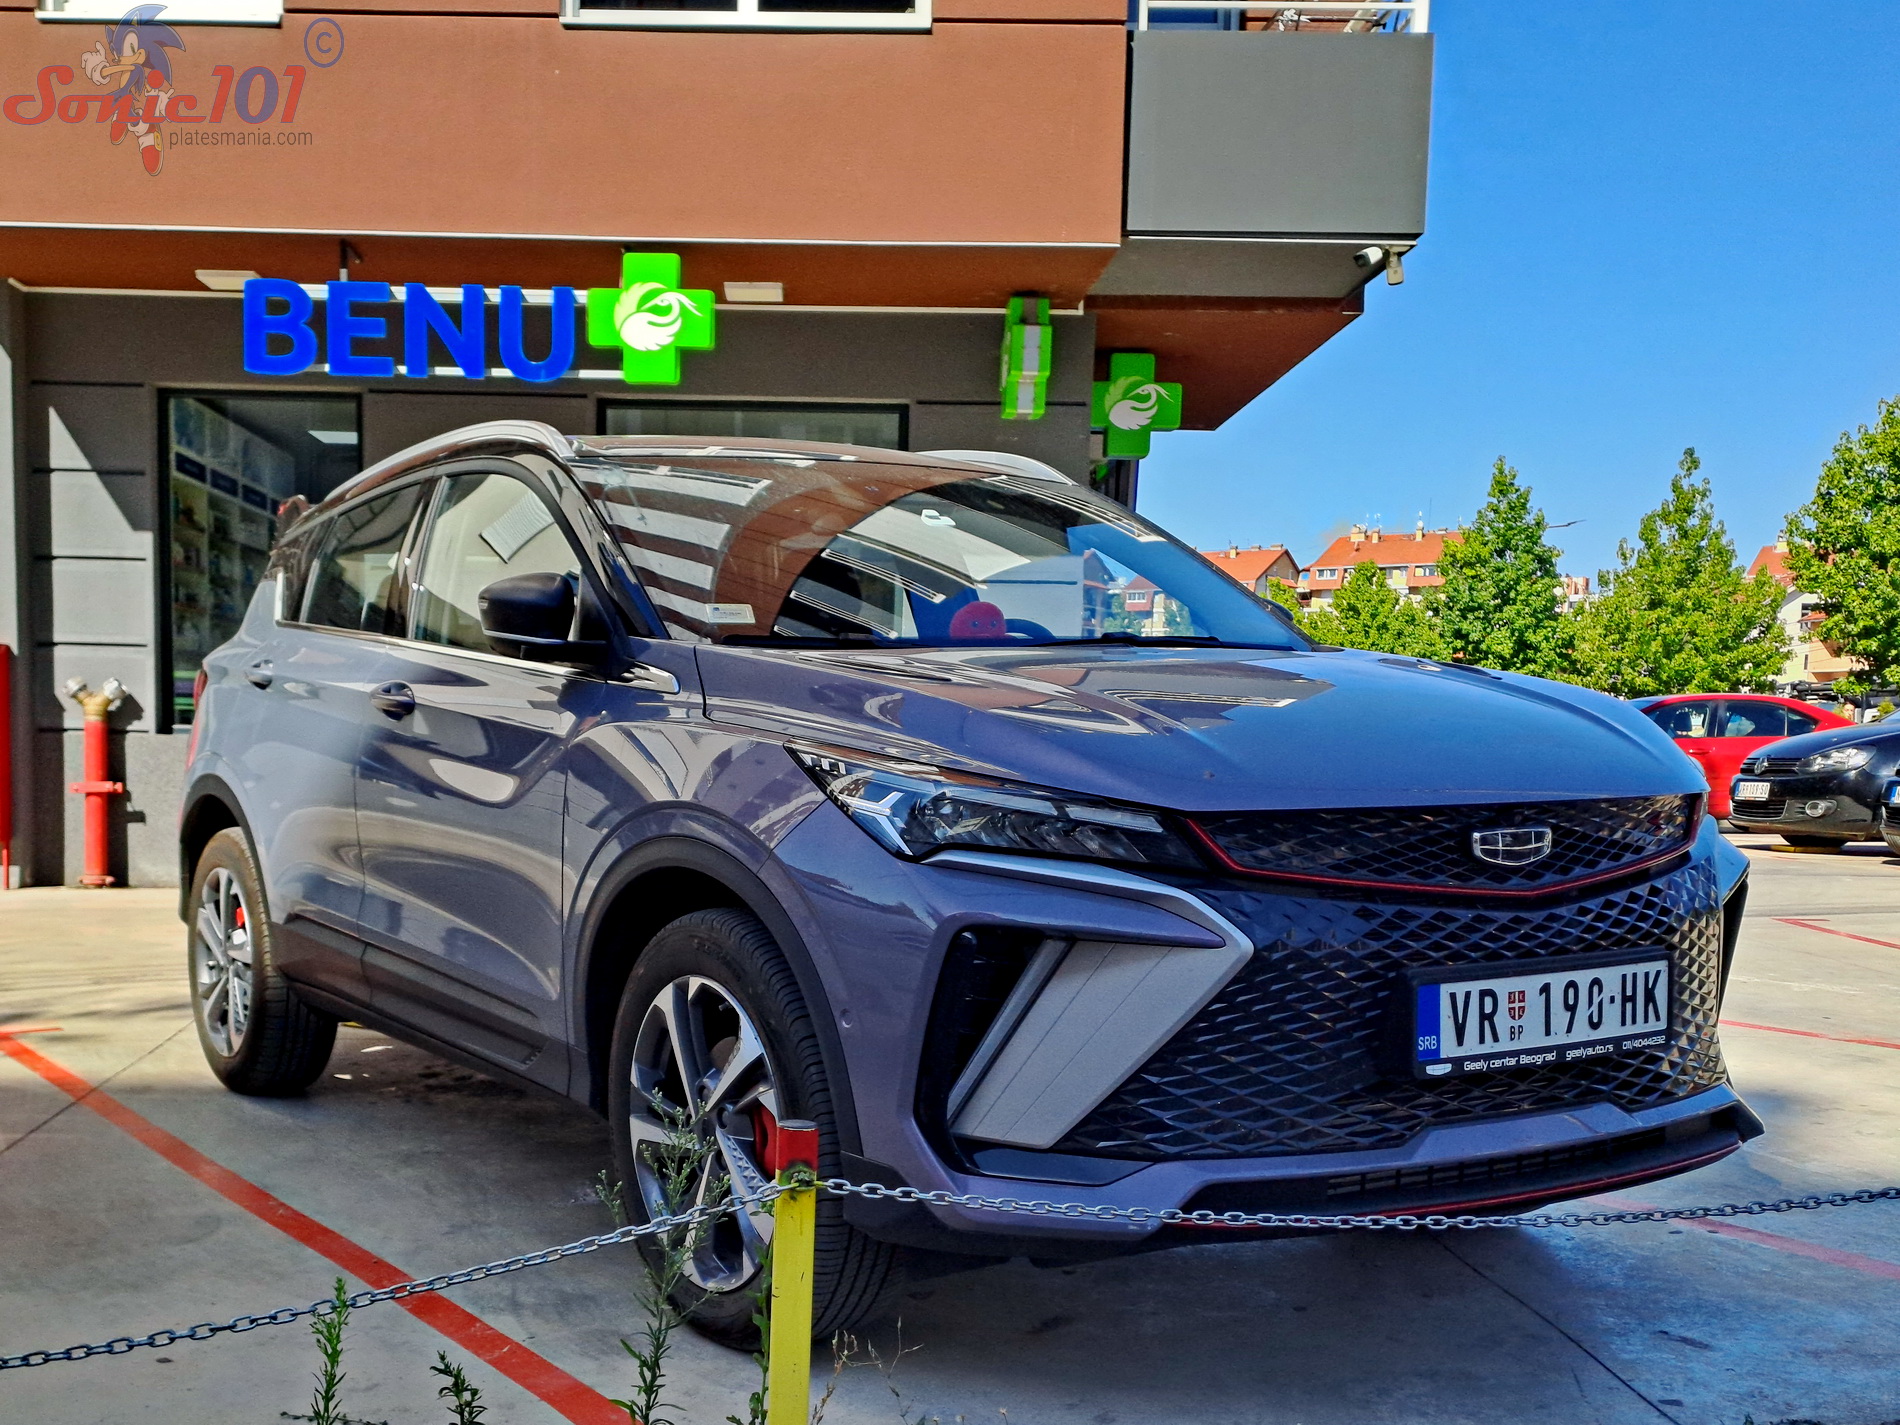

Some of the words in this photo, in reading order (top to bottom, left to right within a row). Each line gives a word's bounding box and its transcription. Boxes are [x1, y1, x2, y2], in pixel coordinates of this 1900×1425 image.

[243, 278, 575, 382] BENU
[1449, 988, 1500, 1047] VR
[1418, 1035, 1438, 1051] SRB
[1464, 1060, 1489, 1071] Geely
[1489, 1056, 1519, 1068] centar
[1519, 1050, 1557, 1065] Beograd
